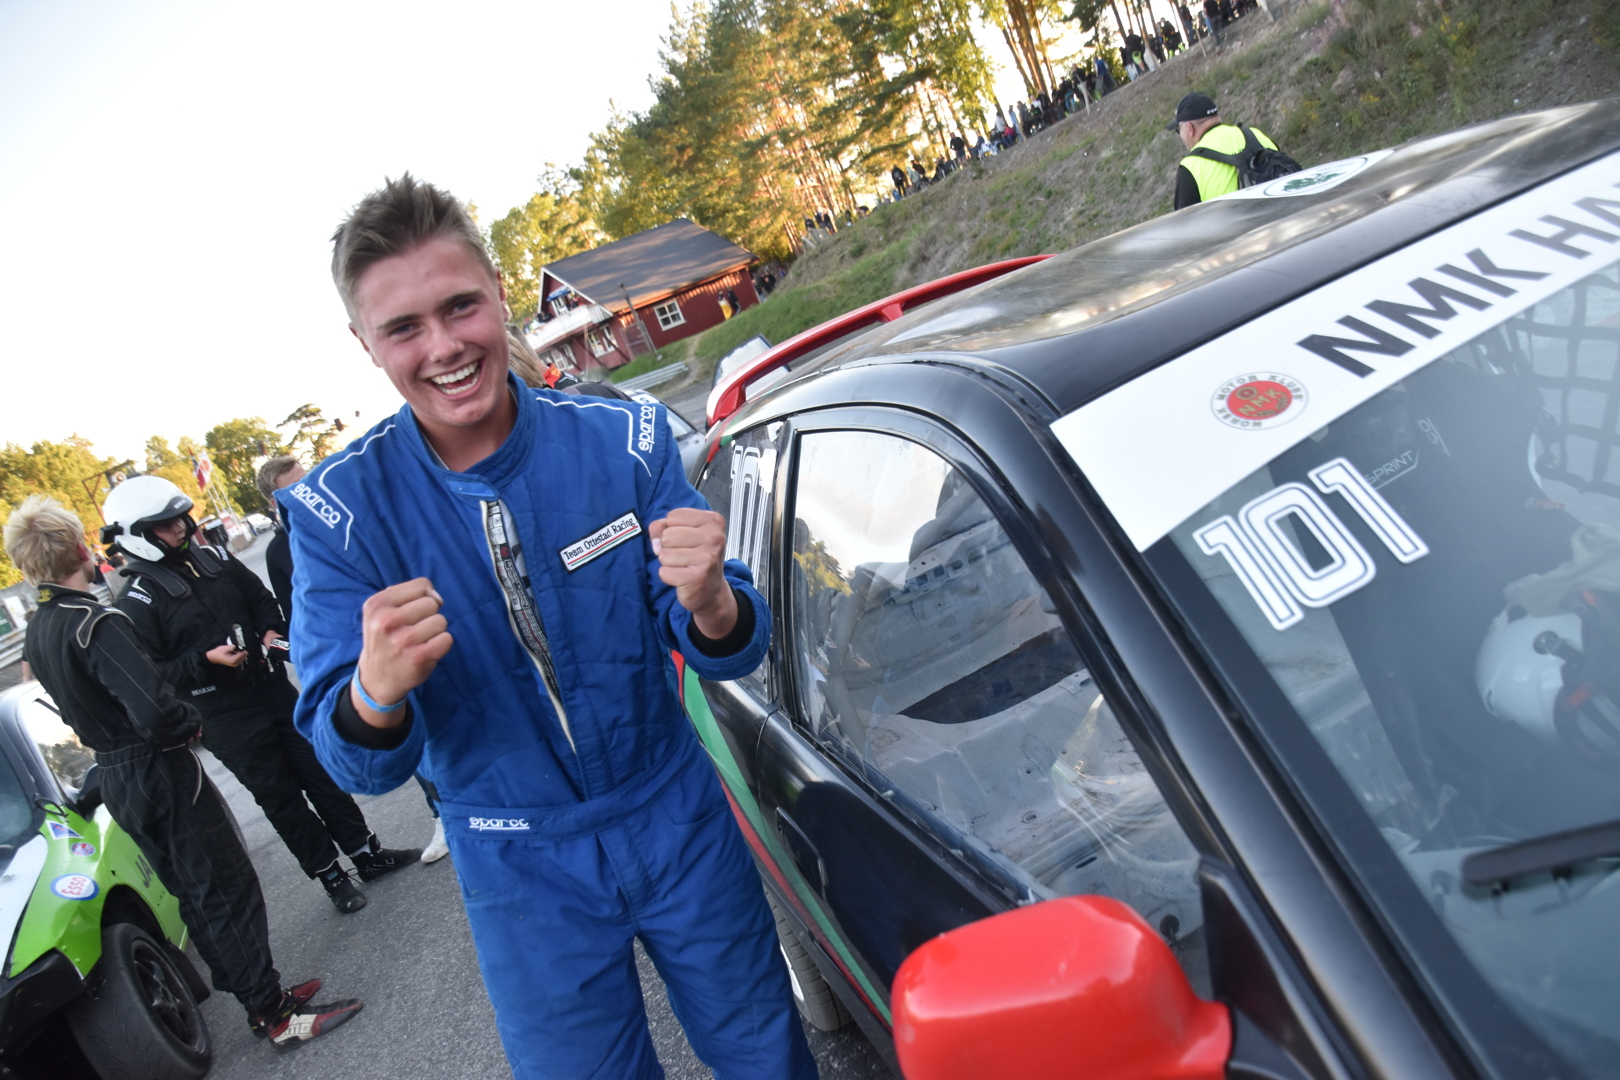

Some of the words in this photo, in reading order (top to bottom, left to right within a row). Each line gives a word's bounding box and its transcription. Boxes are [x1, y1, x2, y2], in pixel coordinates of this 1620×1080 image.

[1294, 247, 1553, 379] NMK
[1506, 183, 1620, 261] HA
[1216, 374, 1258, 401] MOTOR
[1237, 387, 1283, 416] NMK
[638, 405, 655, 453] sparco
[1365, 450, 1413, 485] SPRINT
[291, 483, 341, 528] sparco
[563, 546, 585, 560] Team
[583, 528, 612, 550] Ottestad
[611, 518, 636, 534] Racing
[1192, 456, 1430, 631] 101
